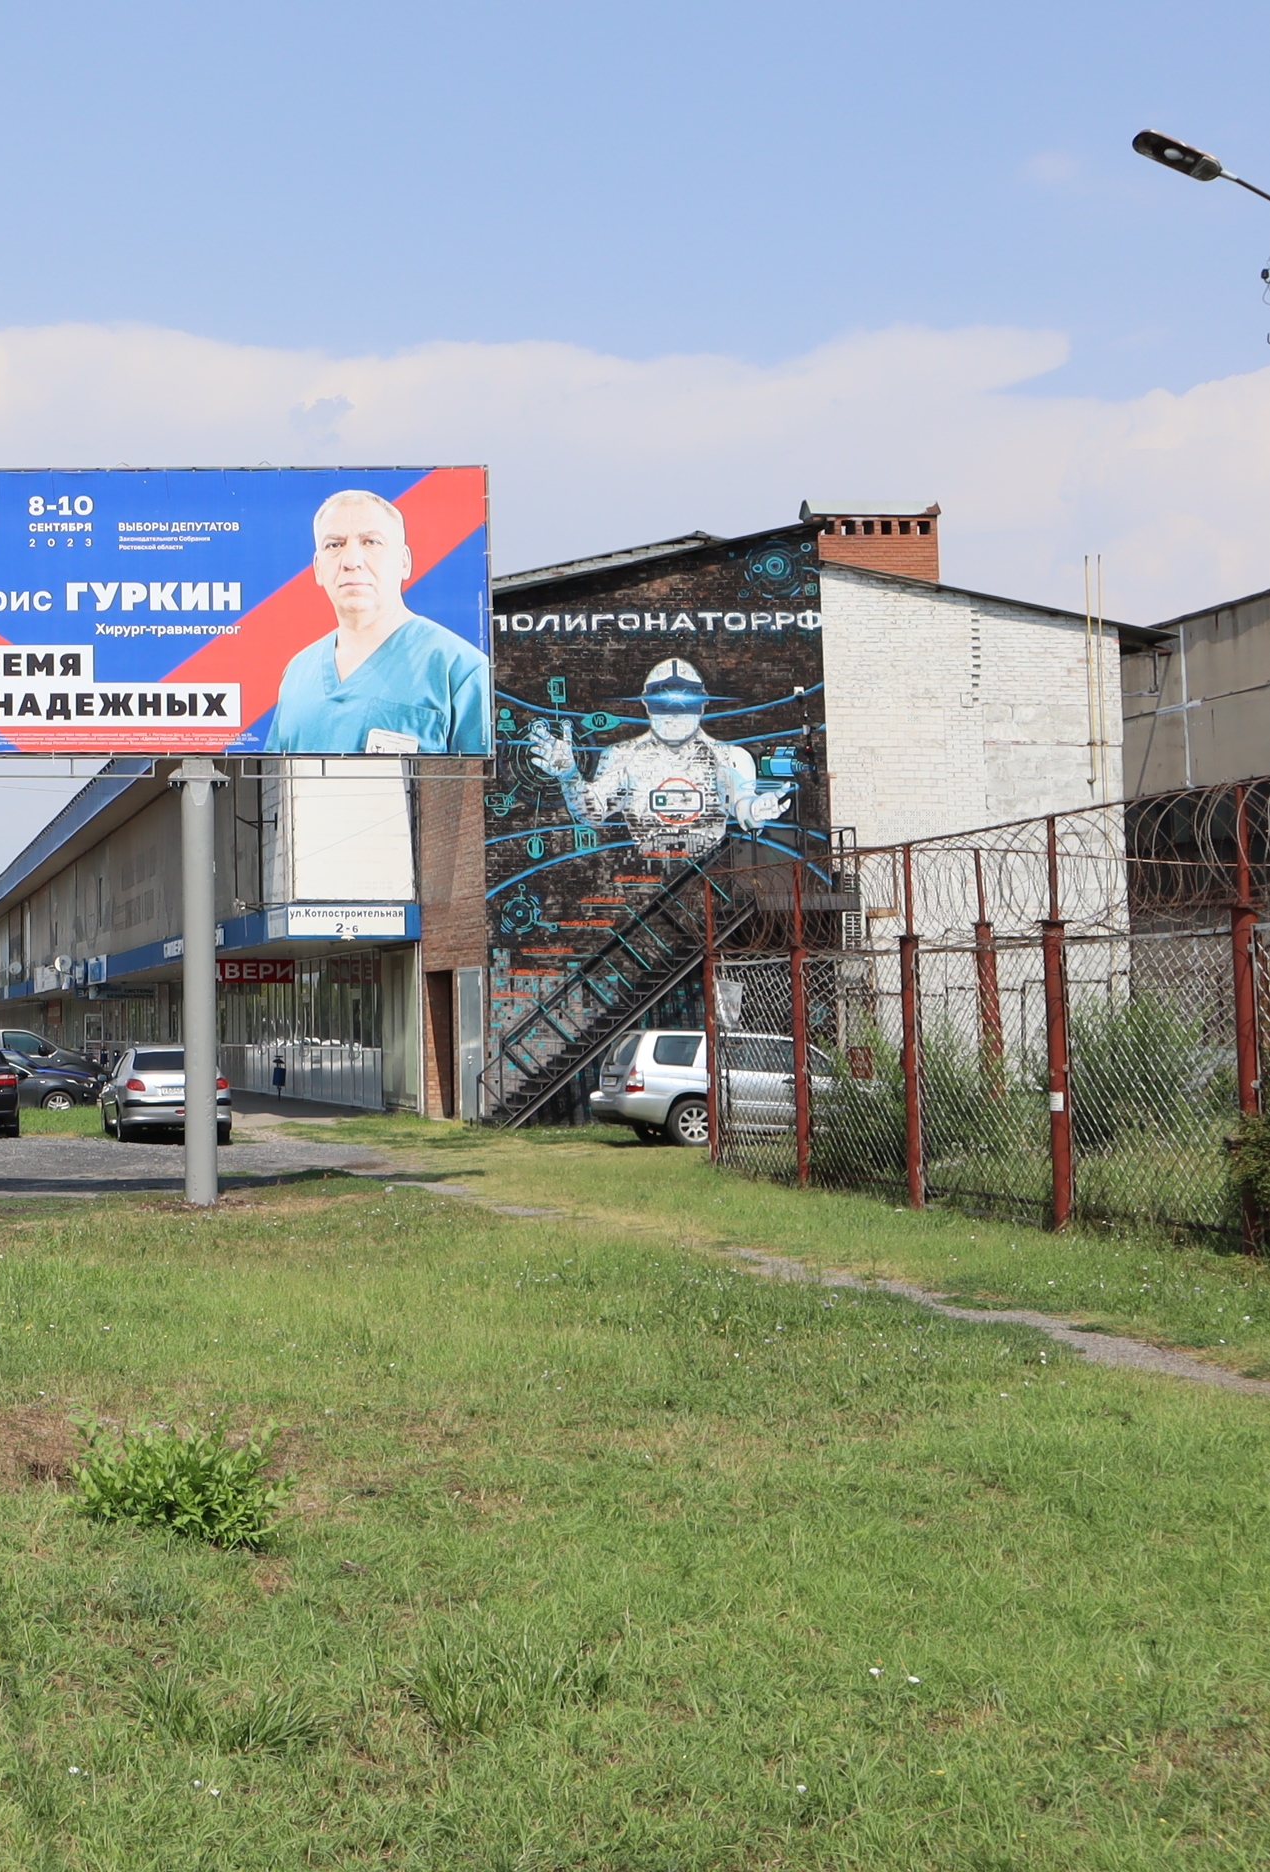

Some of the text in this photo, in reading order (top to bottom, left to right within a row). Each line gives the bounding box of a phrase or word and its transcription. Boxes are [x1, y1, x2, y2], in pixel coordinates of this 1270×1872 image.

[28, 495, 94, 516] 8-10
[28, 522, 93, 532] СЕНТЯБРЯ
[118, 522, 240, 533] ВЫБОРЫ ДЕПУТАТОВ
[66, 582, 241, 612] ГУРКИН
[95, 623, 241, 637] Хирург-травматолог
